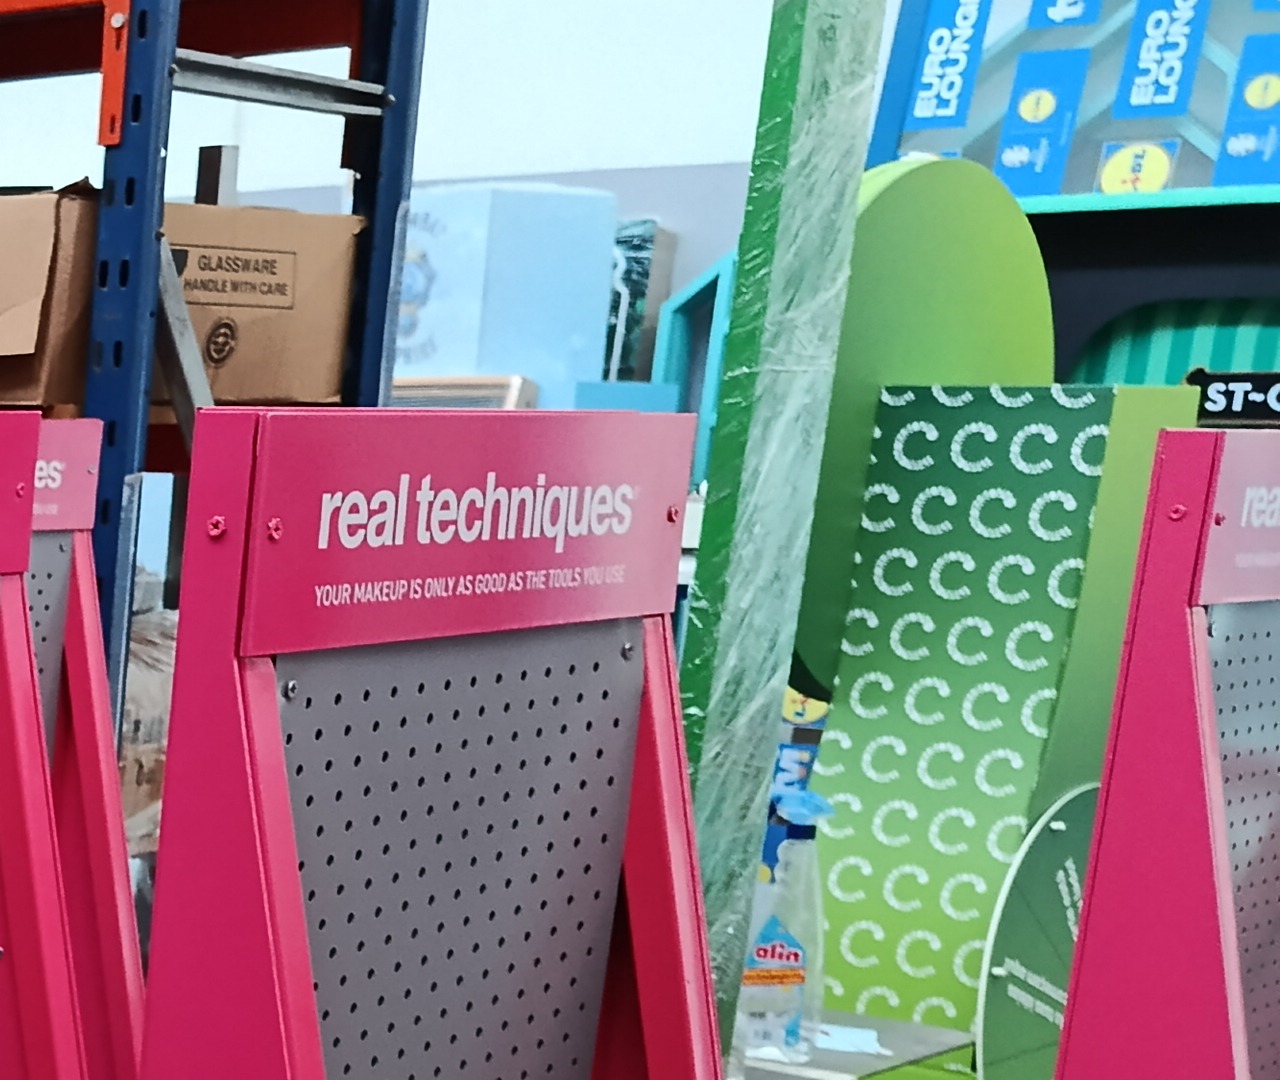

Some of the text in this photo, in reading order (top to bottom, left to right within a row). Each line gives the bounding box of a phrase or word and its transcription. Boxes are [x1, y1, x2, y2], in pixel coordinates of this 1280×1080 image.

[197, 254, 278, 276] GLASSWARE
[183, 278, 228, 294] HANDLE
[259, 281, 289, 297] CARE
[318, 473, 410, 549] real
[315, 565, 627, 607] YOUR MAKEUP IS ONLY AS GOOD AS THE TOOLS YOU USE
